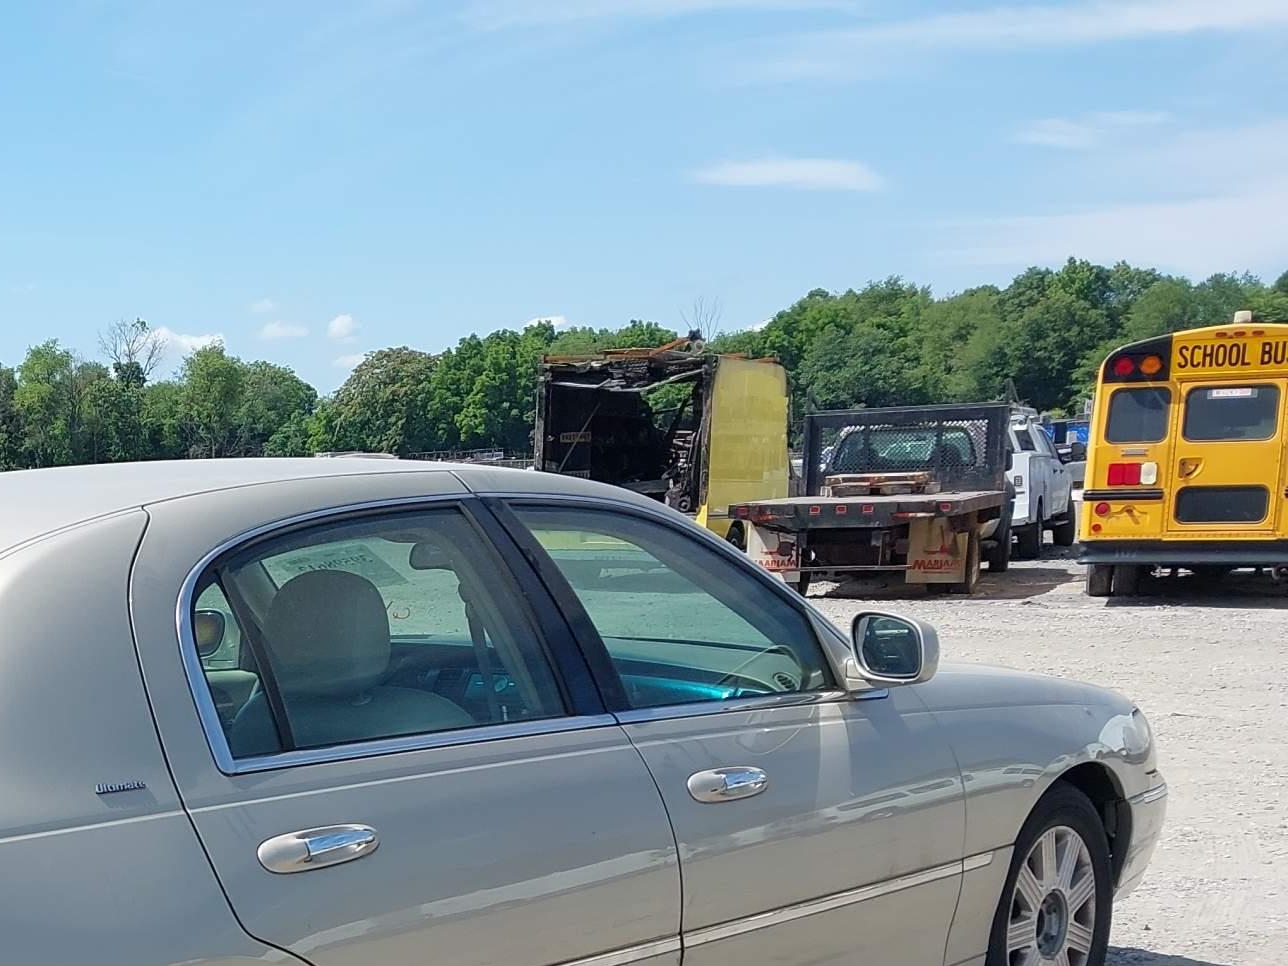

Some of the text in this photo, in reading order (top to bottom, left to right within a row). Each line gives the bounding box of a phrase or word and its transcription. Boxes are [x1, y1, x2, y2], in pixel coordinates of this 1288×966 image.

[1177, 341, 1288, 369] SCHOOL BU
[95, 780, 146, 794] Ultimate
